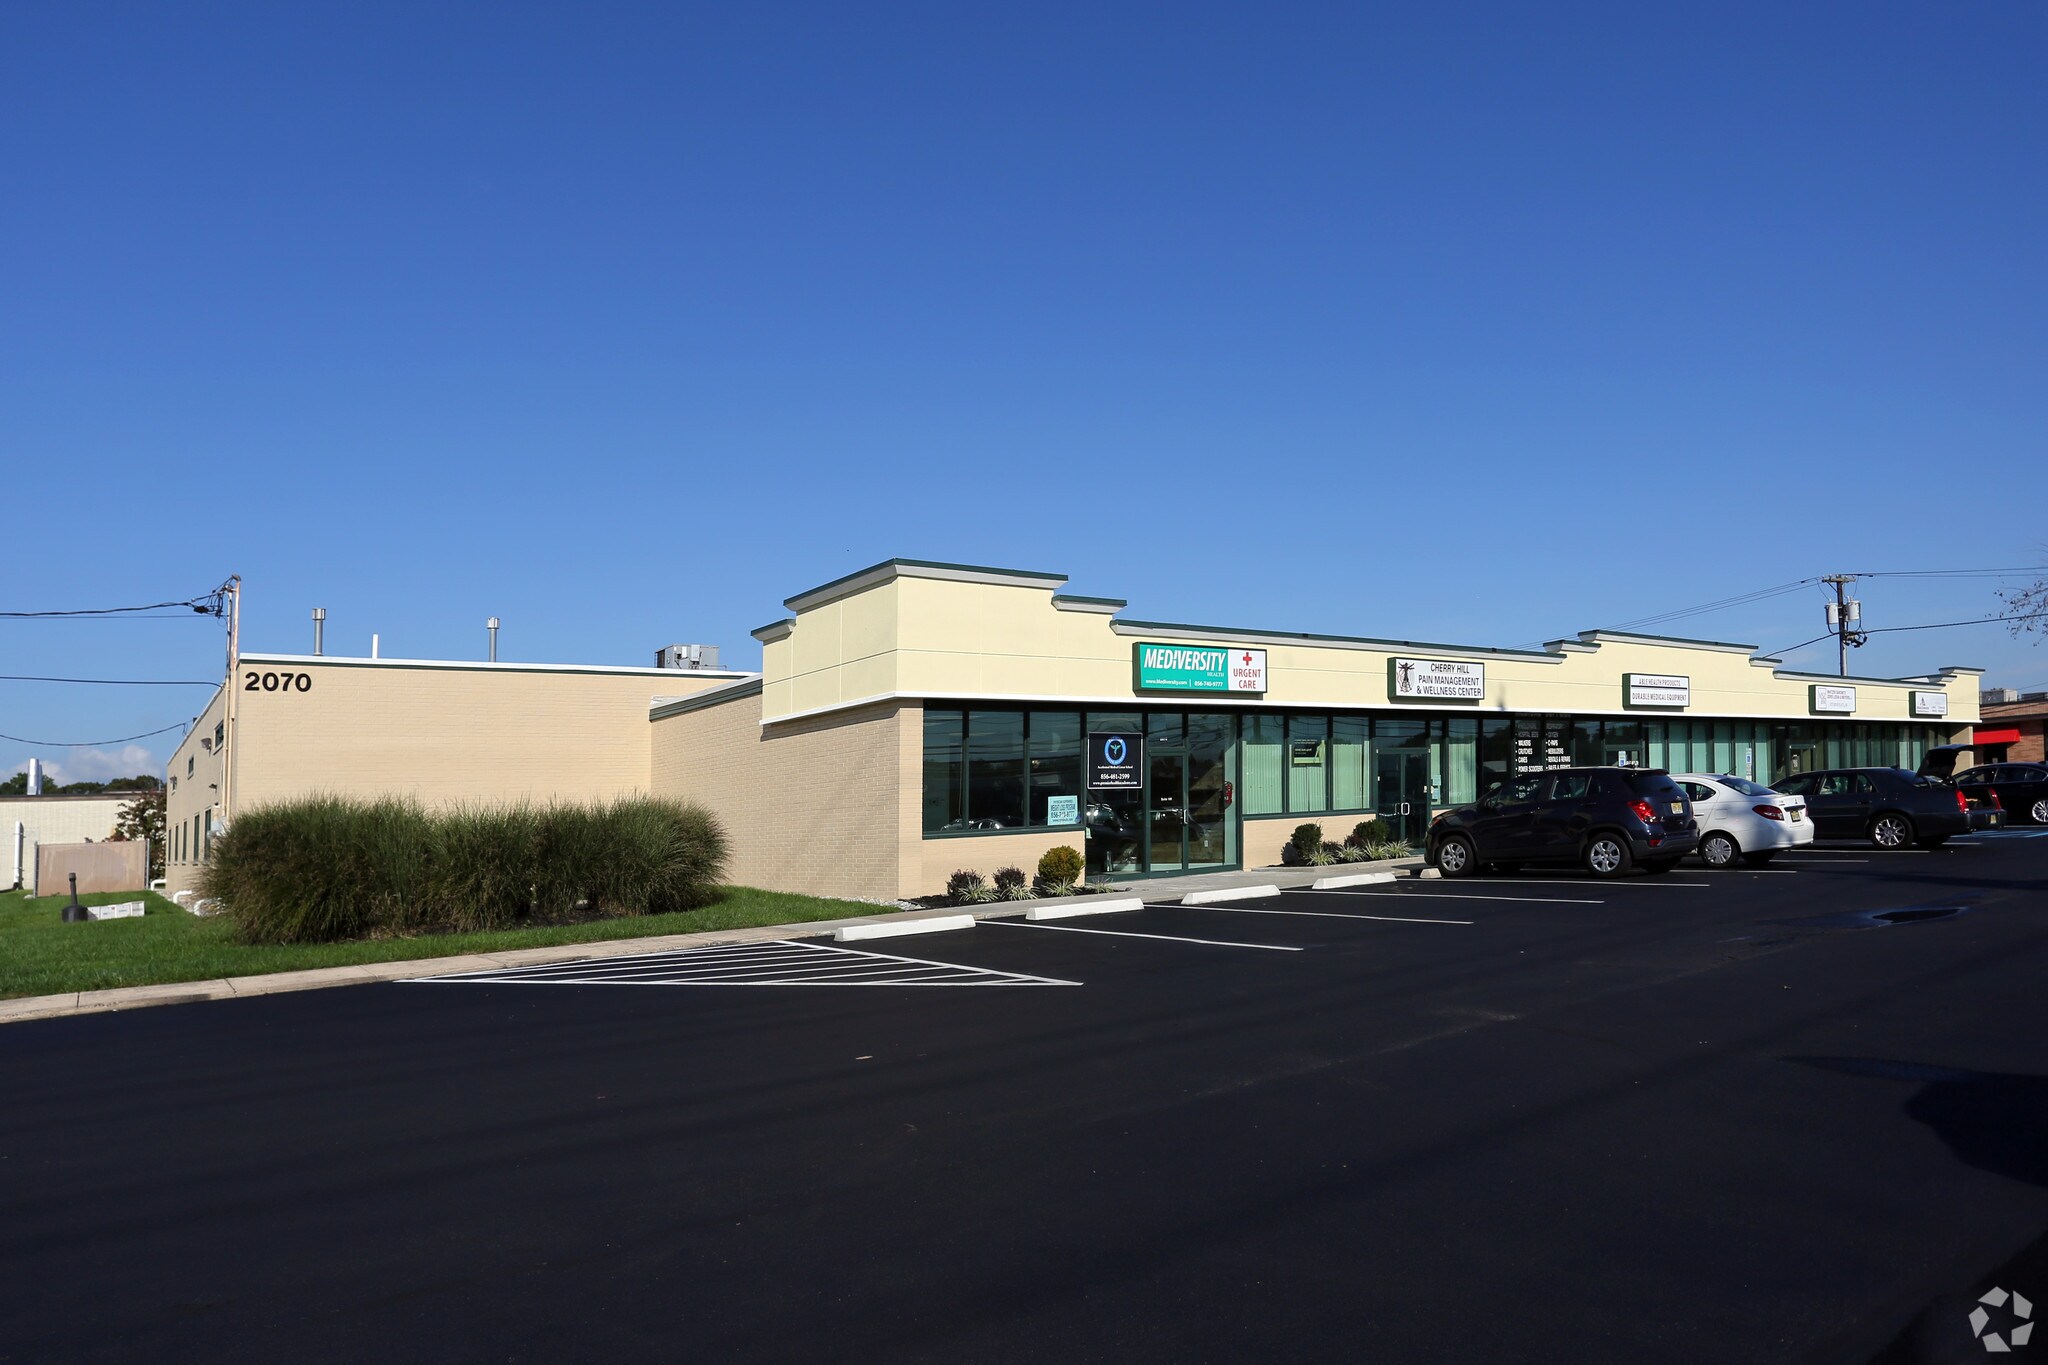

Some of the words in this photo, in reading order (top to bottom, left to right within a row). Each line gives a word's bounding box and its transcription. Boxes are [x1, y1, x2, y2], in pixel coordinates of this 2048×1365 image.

[1233, 668, 1261, 678] URGENT
[1430, 663, 1456, 673] CHERRY
[1457, 665, 1470, 674] HILL
[245, 671, 312, 692] 2070
[1238, 680, 1257, 689] CARE
[1418, 674, 1433, 684] PAIN
[1434, 675, 1480, 686] MANAGEMENT
[1648, 678, 1662, 686] HEALTH
[1662, 679, 1681, 687] PRODUCTS
[1416, 685, 1422, 695] &
[1423, 685, 1456, 696] WELLNESS
[1457, 687, 1482, 697] CENTER
[1632, 692, 1650, 700] DURABLE
[1650, 693, 1667, 701] MEDICAL
[1667, 693, 1687, 702] EQUIPMENT
